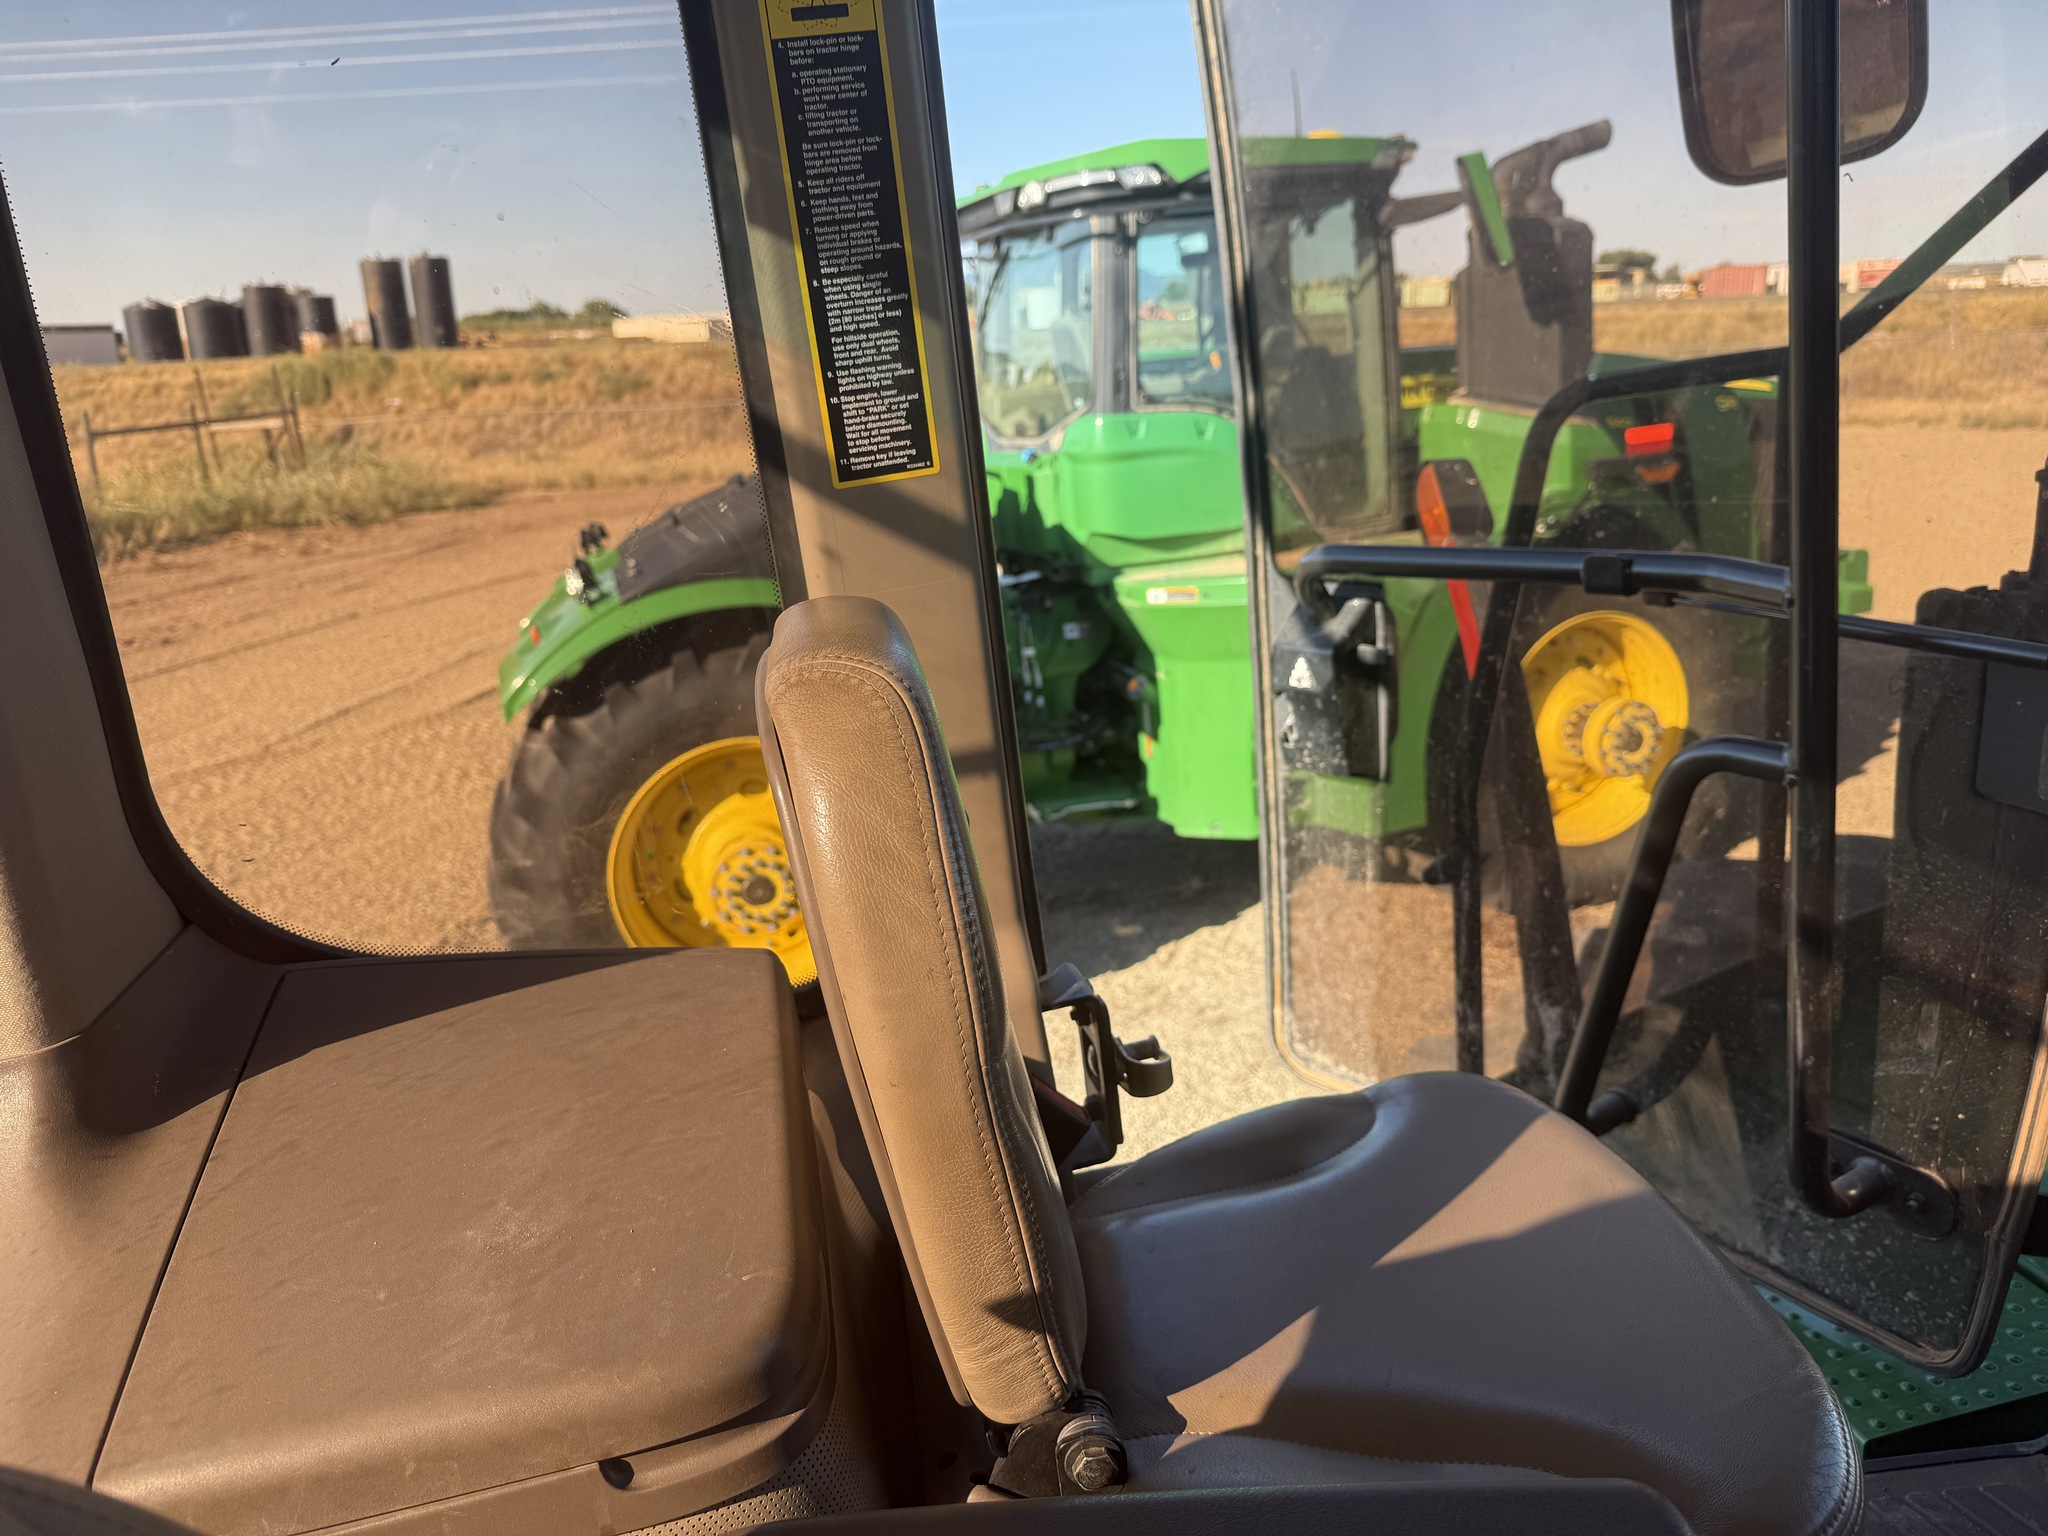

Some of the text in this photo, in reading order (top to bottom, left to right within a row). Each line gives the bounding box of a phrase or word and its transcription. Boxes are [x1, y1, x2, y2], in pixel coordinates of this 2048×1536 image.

[787, 39, 808, 48] Install
[810, 37, 837, 46] lock-pin
[789, 49, 804, 57] bars
[816, 46, 838, 54] tractor
[840, 44, 859, 53] hinge
[799, 65, 866, 79] operating stationary
[801, 77, 815, 85] PTO
[802, 82, 865, 96] performing service
[803, 94, 820, 102] work
[837, 91, 859, 99] center
[826, 109, 848, 117] tractor
[807, 118, 848, 128] transporting
[808, 128, 833, 136] another
[829, 138, 856, 147] lock-pin
[866, 135, 882, 143] lock-
[832, 146, 861, 155] removed
[804, 159, 823, 167] hinge
[841, 155, 862, 163] before
[806, 166, 838, 176] operating
[807, 179, 824, 187] Keep
[809, 184, 845, 194] tractor and
[812, 206, 839, 214] clothing
[813, 212, 856, 224] power-driven
[841, 222, 861, 232] speed
[816, 233, 840, 242] turning
[849, 229, 877, 239] applying
[817, 240, 849, 249] individual
[818, 245, 874, 259] operating around
[829, 256, 849, 265] rough
[850, 253, 873, 263] ground
[832, 275, 864, 285] especially
[866, 271, 888, 280] careful
[842, 283, 861, 292] using
[862, 280, 881, 289] single
[850, 290, 873, 299] Danger
[826, 293, 908, 309] overturn increases greatly
[827, 303, 882, 317] with narrow tread
[830, 325, 842, 333] and
[843, 323, 858, 331] high
[844, 333, 867, 342] hillside
[846, 342, 860, 350] only
[861, 339, 875, 347] dual
[834, 351, 849, 359] front
[850, 349, 863, 357] and
[881, 344, 899, 352] Avoid
[835, 359, 854, 367] sharp
[855, 355, 873, 365] uphill
[850, 366, 876, 375] flashing
[876, 362, 902, 373] warning
[837, 376, 856, 385] lights
[866, 371, 892, 382] highway
[894, 368, 915, 376] unless
[839, 381, 871, 393] prohibited
[872, 380, 880, 388] by
[840, 395, 855, 404] Stop
[880, 389, 897, 397] lower
[842, 399, 875, 410] implement
[883, 395, 906, 405] ground
[843, 409, 857, 417] shift
[844, 410, 906, 425] hand-brake securely
[845, 424, 865, 432] before
[880, 424, 912, 434] movement
[870, 435, 890, 443] before
[849, 445, 877, 454] servicing
[850, 455, 875, 463] Remove
[894, 449, 916, 457] leaving
